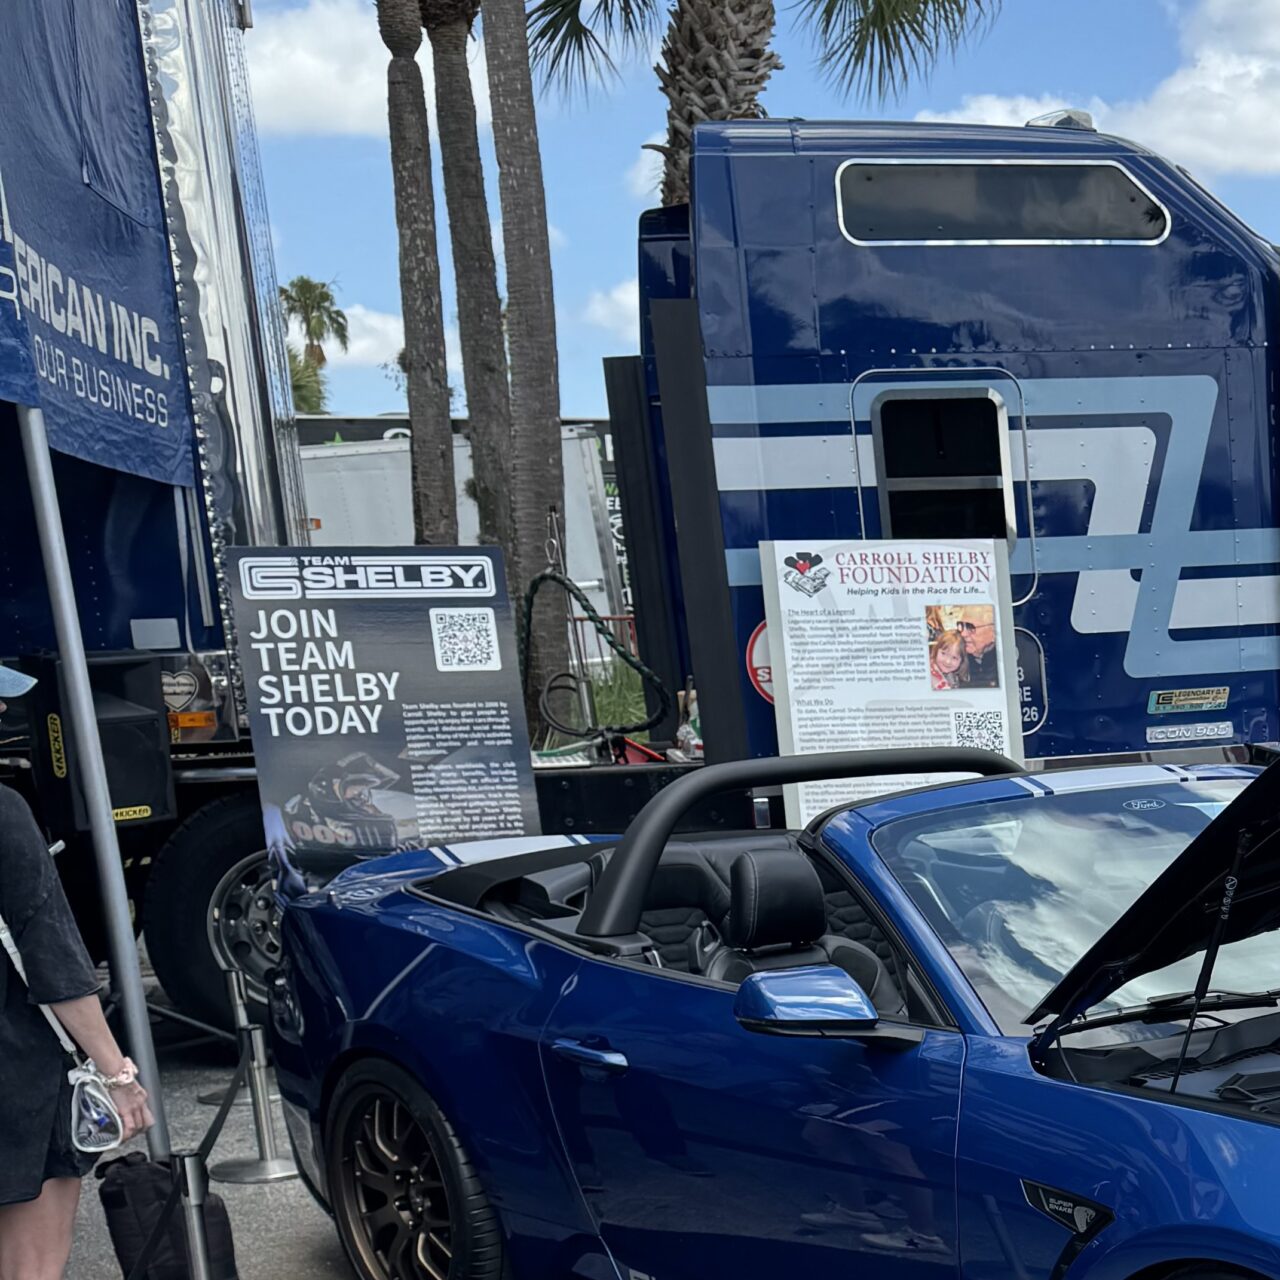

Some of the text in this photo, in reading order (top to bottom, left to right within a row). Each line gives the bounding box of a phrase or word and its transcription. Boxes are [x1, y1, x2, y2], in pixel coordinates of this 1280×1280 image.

[13, 232, 107, 355] ERICAN
[112, 301, 170, 380] INC.
[72, 358, 169, 428] BUSINESS
[301, 556, 349, 566] TEAM
[835, 551, 992, 566] CARROLL SHELBY
[302, 566, 484, 589] SHELBY
[838, 565, 992, 584] FOUNDATION
[847, 588, 879, 596] Helping
[881, 587, 900, 595] Kids
[902, 587, 910, 595] in
[912, 587, 925, 595] the
[949, 586, 961, 594] for
[250, 609, 338, 640] JOIN
[251, 641, 355, 671] TEAM
[258, 671, 400, 704] SHELBY
[260, 704, 382, 736] TODAY
[119, 807, 149, 818] KICKER
